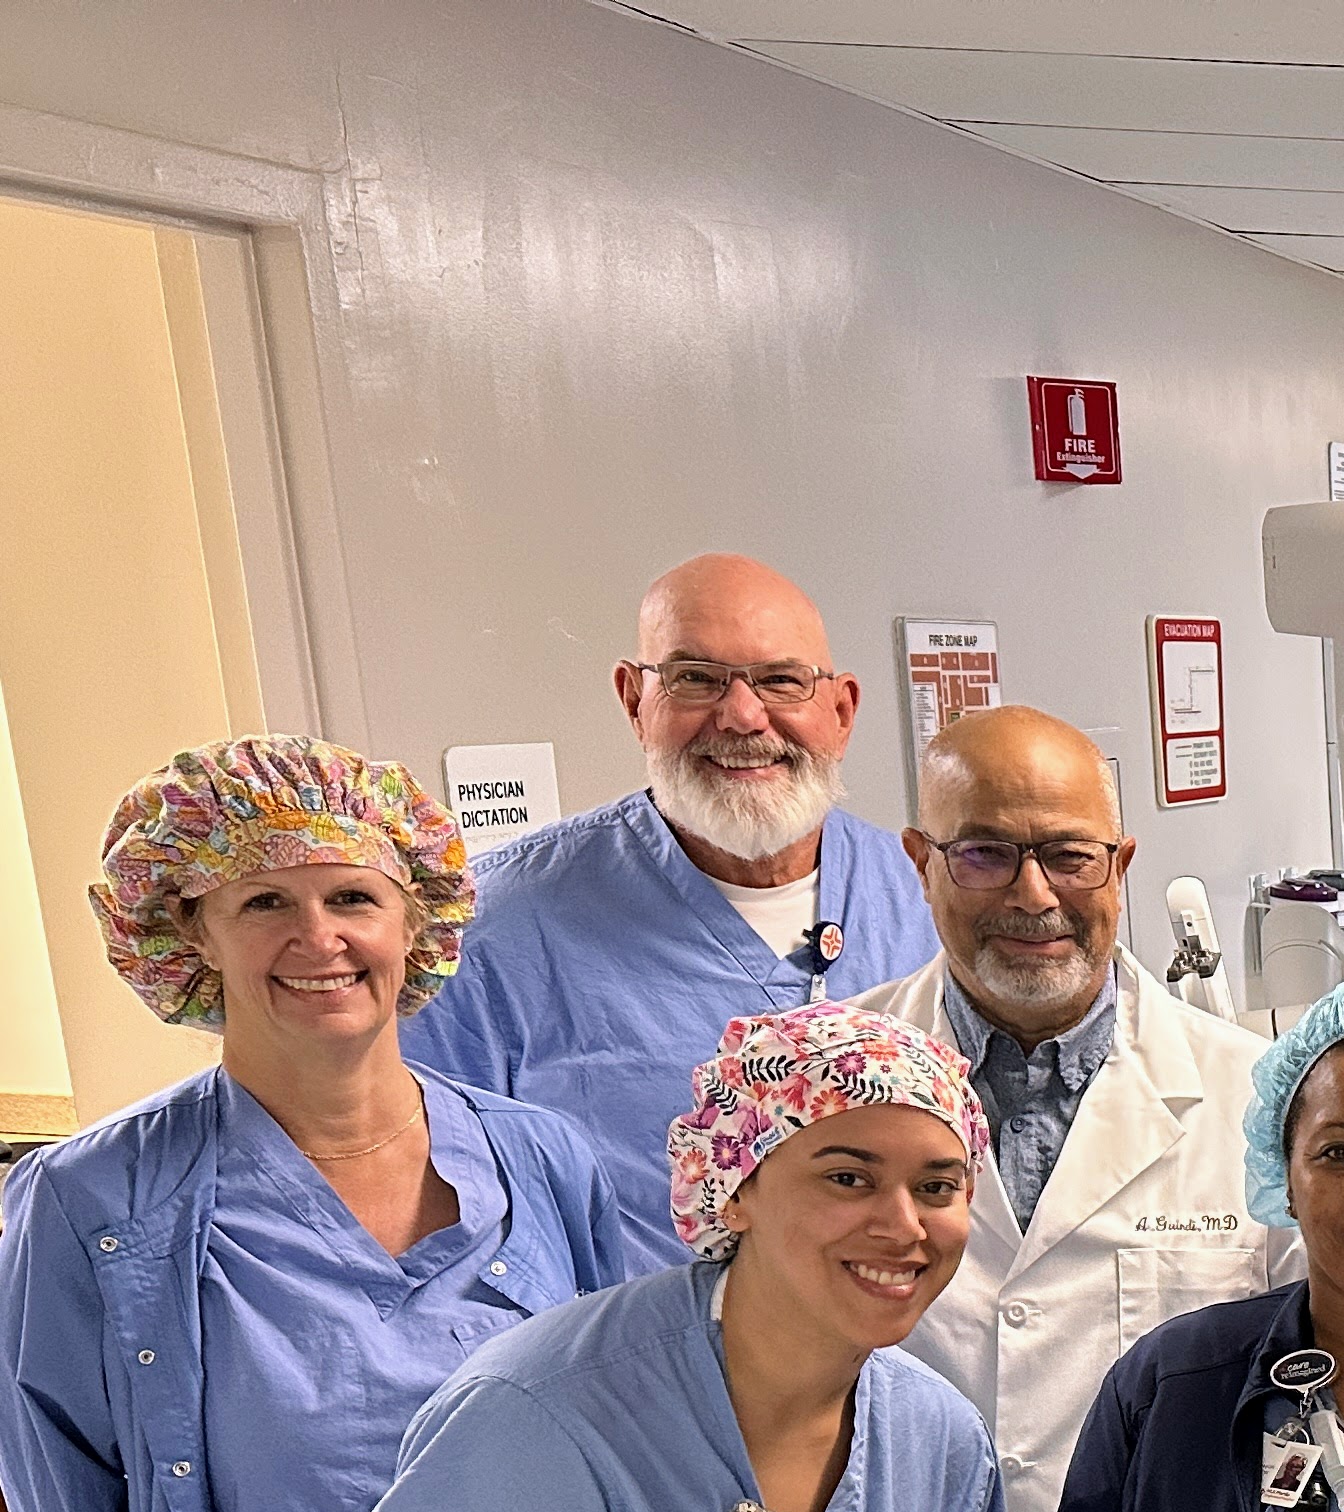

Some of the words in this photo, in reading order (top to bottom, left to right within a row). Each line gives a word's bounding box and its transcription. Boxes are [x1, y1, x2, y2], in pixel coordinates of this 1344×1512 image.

[1064, 438, 1096, 453] FIRE
[1056, 451, 1105, 464] Extinguisher
[1164, 623, 1201, 637] EVACUATION
[1202, 624, 1215, 638] MAP
[928, 634, 944, 647] FIRE
[944, 634, 963, 647] ZONE
[963, 635, 978, 647] MAP
[458, 780, 525, 802] PHYSICIAN
[461, 806, 529, 829] DICTATION
[1201, 1214, 1239, 1231] MD
